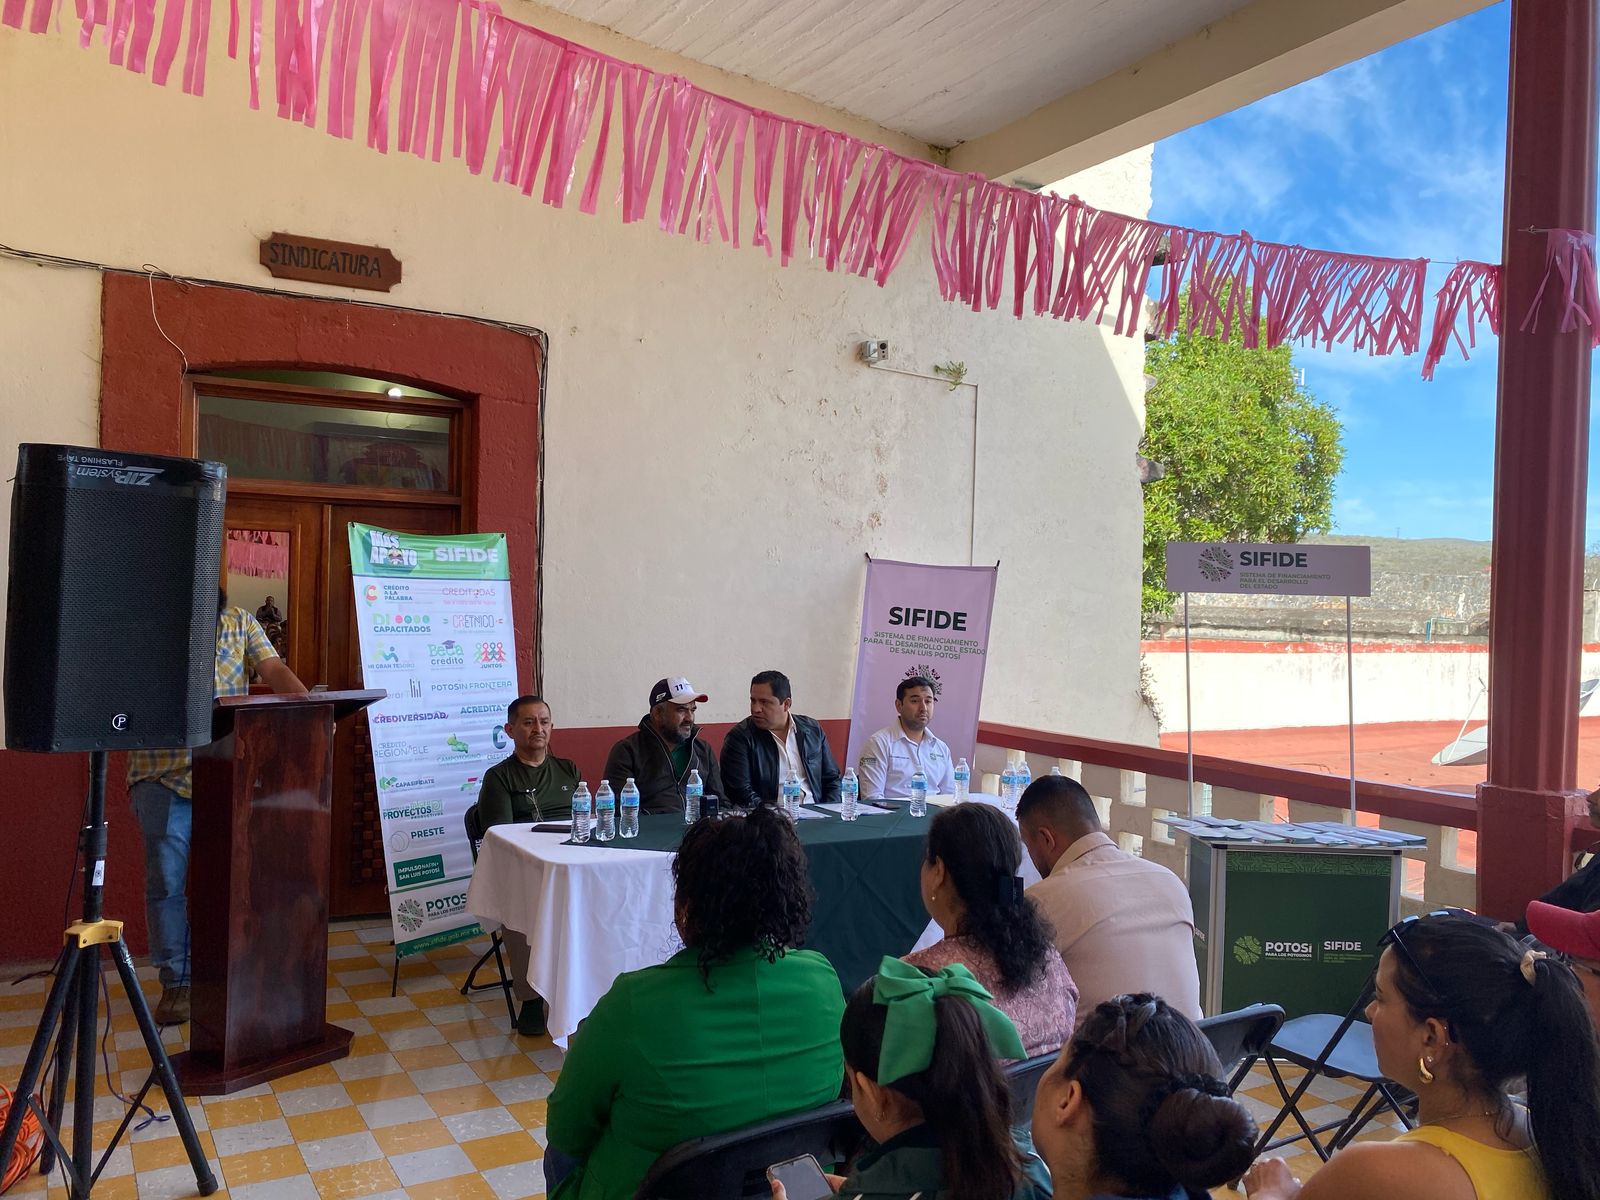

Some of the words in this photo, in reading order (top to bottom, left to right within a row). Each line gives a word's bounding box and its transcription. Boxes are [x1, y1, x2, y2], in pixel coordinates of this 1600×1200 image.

[269, 242, 382, 278] SINDICATURA
[80, 456, 123, 467] FLASHING
[435, 547, 498, 562] SIFIDE
[1239, 551, 1308, 568] SIFIDE
[1277, 572, 1331, 580] FINANCIAMIENTO
[888, 606, 968, 631] SIFIDE
[373, 625, 432, 633] CAPACITADOS
[874, 631, 905, 640] SISTEMA
[917, 635, 979, 647] FINANCIAMIENTO
[863, 637, 884, 645] PARA
[895, 640, 942, 651] DESARROLLO
[959, 646, 986, 656] ESTADO
[889, 646, 900, 654] DE
[900, 647, 916, 656] SAN
[917, 649, 934, 658] LUIS
[373, 711, 449, 724] CREDIVERSIDAD
[382, 805, 432, 820] PROYECTOS
[411, 826, 445, 839] PRESTE
[398, 864, 422, 873] IMPULSO
[426, 893, 467, 912] POTOS
[1323, 940, 1362, 951] SIFIDE
